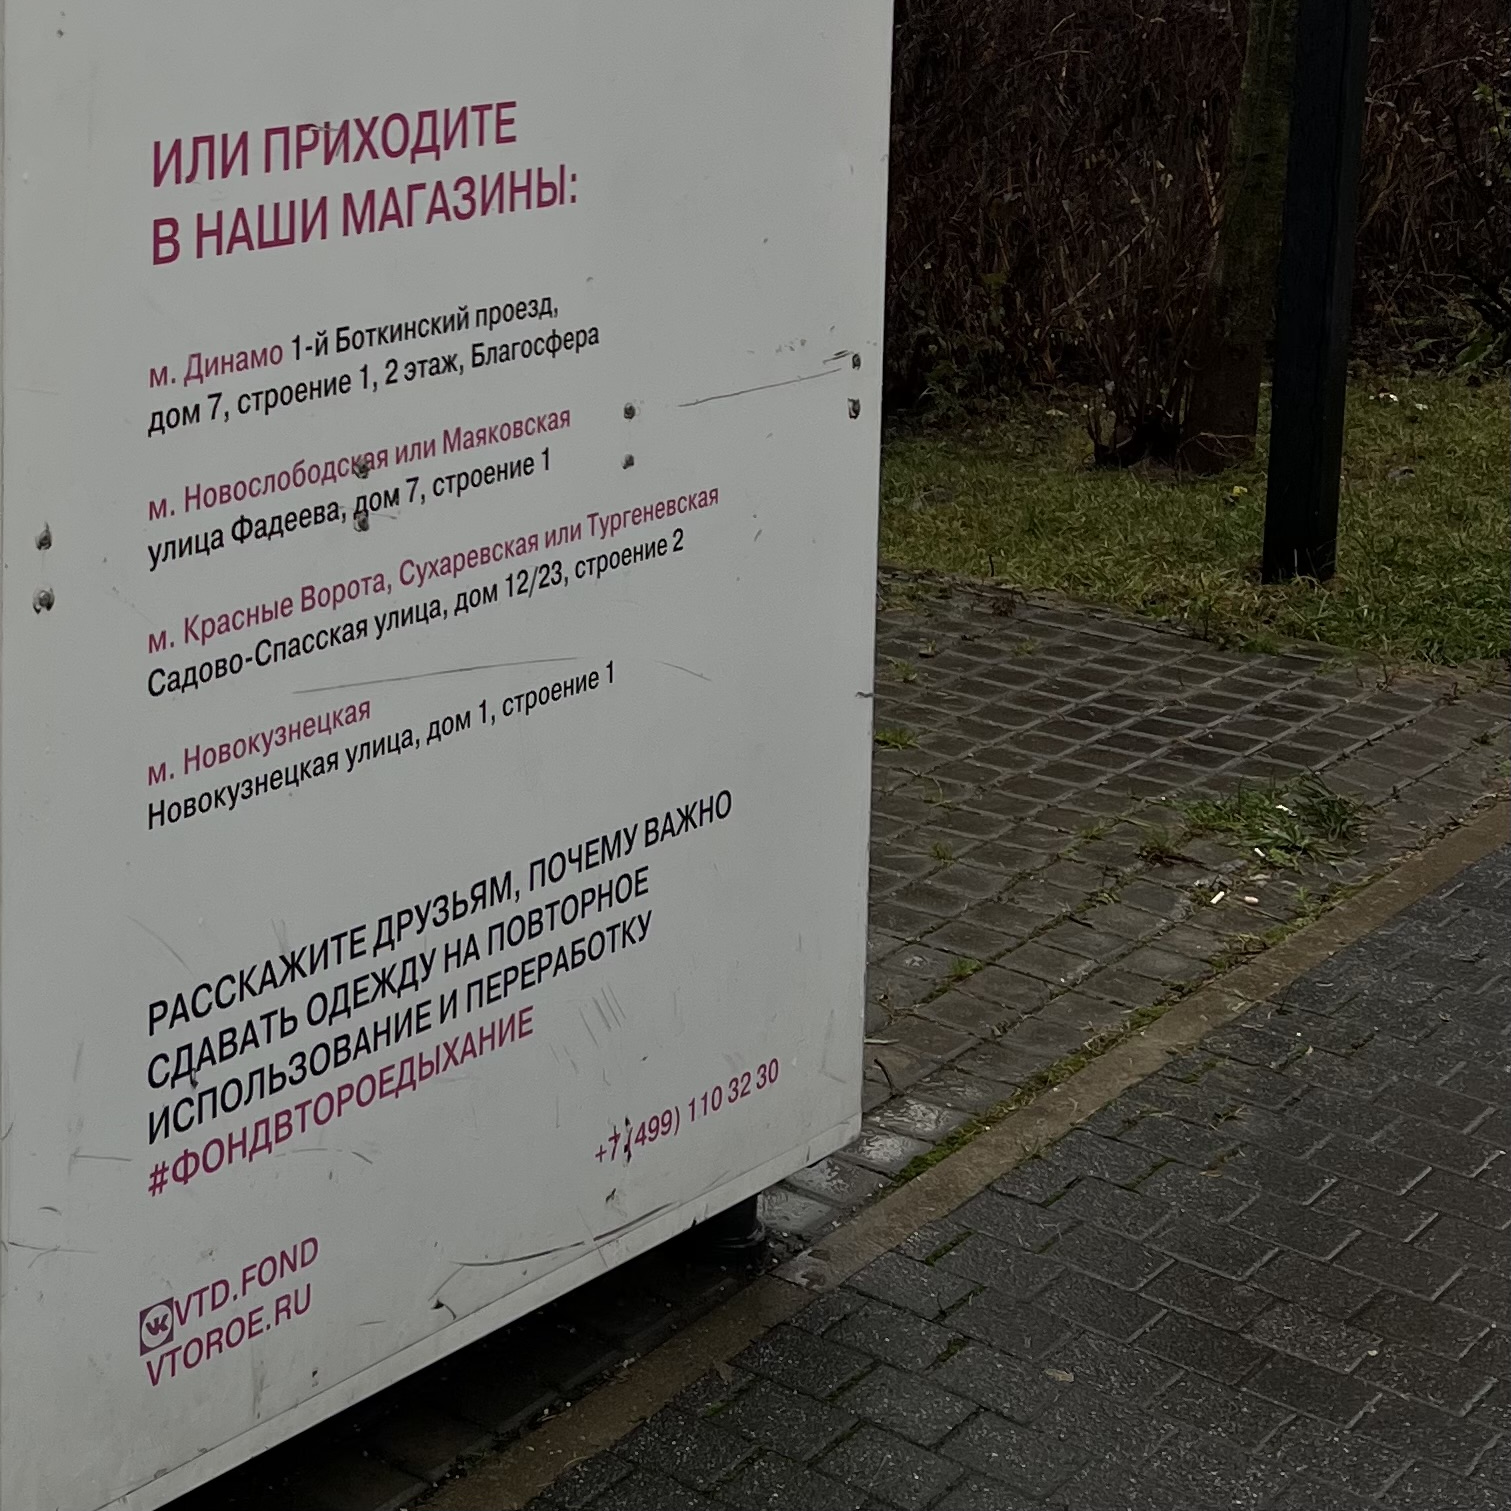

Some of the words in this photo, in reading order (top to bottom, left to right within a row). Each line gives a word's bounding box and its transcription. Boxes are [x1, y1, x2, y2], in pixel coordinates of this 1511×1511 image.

[154, 131, 248, 187] ИЛИ
[265, 101, 516, 173] ПРИХОДИТЕ
[153, 218, 180, 265] В
[196, 196, 327, 259] НАШИ
[343, 164, 576, 236] МАГАЗИНЫ:
[148, 404, 200, 438] дом
[208, 392, 229, 422] 7,
[238, 374, 351, 415] строение
[360, 364, 377, 392] 1,
[385, 358, 398, 385] 2
[404, 354, 463, 381] этаж,
[472, 327, 599, 368] Благосфера
[150, 366, 175, 387] м.
[184, 345, 282, 387] Динамо
[292, 330, 328, 360] 1-й
[336, 305, 469, 353] Боткинский
[476, 297, 558, 331] проезд,
[148, 529, 224, 572] улица
[231, 502, 346, 544] Фадеева,
[353, 488, 399, 519] дом
[406, 476, 425, 505] 7,
[433, 457, 534, 497] строение
[542, 447, 549, 470] 1
[149, 499, 174, 520] м.
[185, 449, 388, 512] Новослободская
[396, 439, 435, 464] или
[444, 410, 570, 454] Маяковская
[148, 619, 367, 696] Садово-Спасская
[374, 599, 447, 640] улица,
[454, 584, 497, 616] дом
[506, 561, 568, 598] 12/23,
[575, 538, 667, 579] строение
[673, 528, 683, 552] 2
[149, 631, 174, 653] м.
[185, 597, 293, 646] Красные
[302, 574, 391, 612] Ворота,
[400, 534, 538, 588] Сухаревская
[545, 523, 581, 548] или
[587, 488, 718, 539] Тургеневская
[149, 762, 174, 786] м.
[185, 701, 369, 774] Новокузнецкая
[149, 751, 338, 830] Новокузнецкая
[345, 729, 420, 773] улица,
[427, 711, 470, 745] дом
[479, 699, 495, 726] 1,
[503, 671, 599, 716] строение
[606, 660, 613, 683] 1
[149, 924, 366, 1036] РАССКАЖИТЕ
[373, 871, 519, 958] ДРУЗЬЯМ,
[530, 823, 638, 891] ПОЧЕМУ
[645, 790, 731, 847] ВАЖНО
[148, 1007, 298, 1089] СДАВАТЬ
[307, 948, 436, 1026] ОДЕЖДУ
[445, 934, 480, 973] НА
[488, 866, 648, 956] ПОВТОРНОЕ
[149, 1000, 431, 1145] ИСПОЛЬЗОВАНИЕ
[440, 989, 457, 1024] И
[467, 910, 652, 1013] ПЕРЕРАБОТКУ
[148, 1006, 533, 1197] #ФОНДВТОРОЕДЫХАНИЕ
[688, 1086, 722, 1122] 110
[728, 1072, 751, 1104] 32
[756, 1058, 779, 1090] 30
[146, 1283, 310, 1386] VTOROE.RU
[175, 1237, 318, 1326] VTD.FOND
